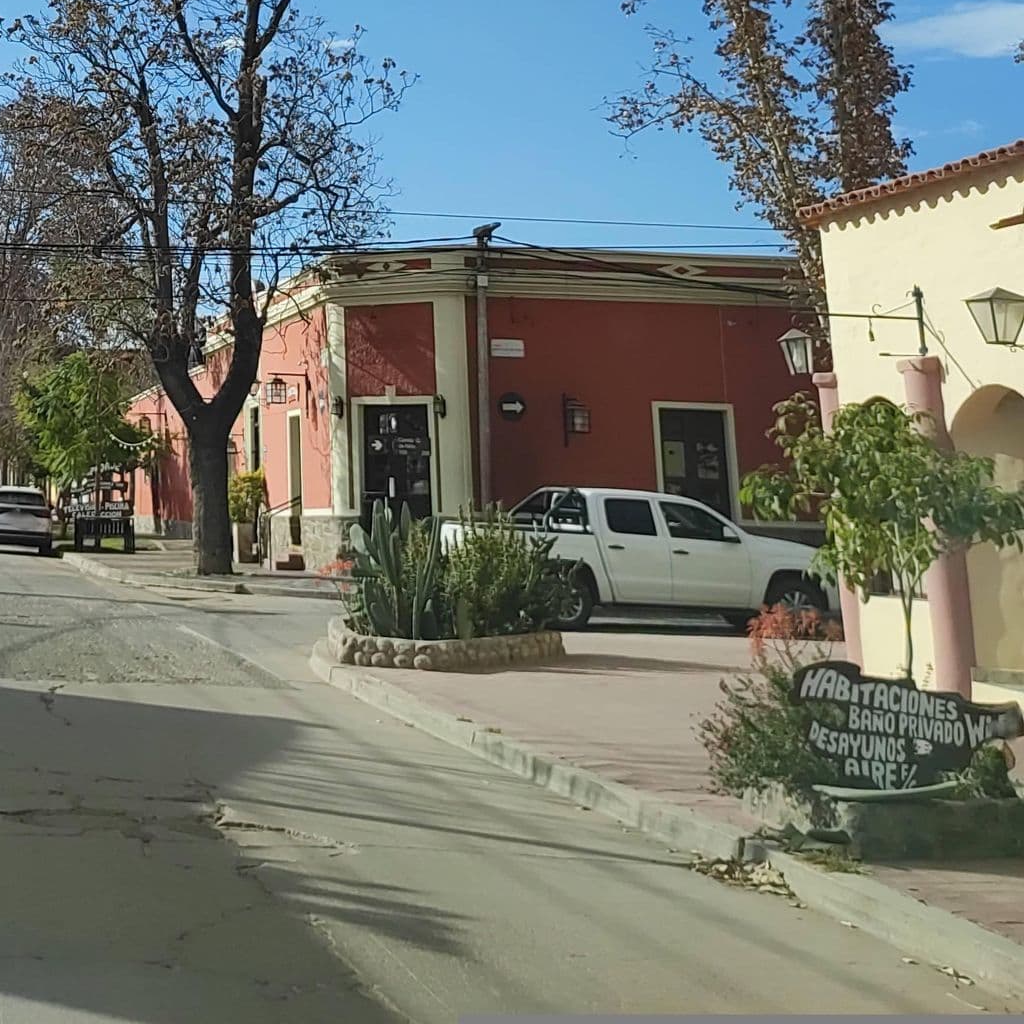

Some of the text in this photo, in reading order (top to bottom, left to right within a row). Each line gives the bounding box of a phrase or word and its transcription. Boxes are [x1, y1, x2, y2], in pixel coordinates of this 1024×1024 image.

[800, 668, 958, 720] HABITACIONES
[808, 720, 906, 763] DESAYUNOS
[848, 705, 896, 734] BAÑO
[898, 713, 964, 747] PRIVADO
[844, 758, 897, 790] AIRE
